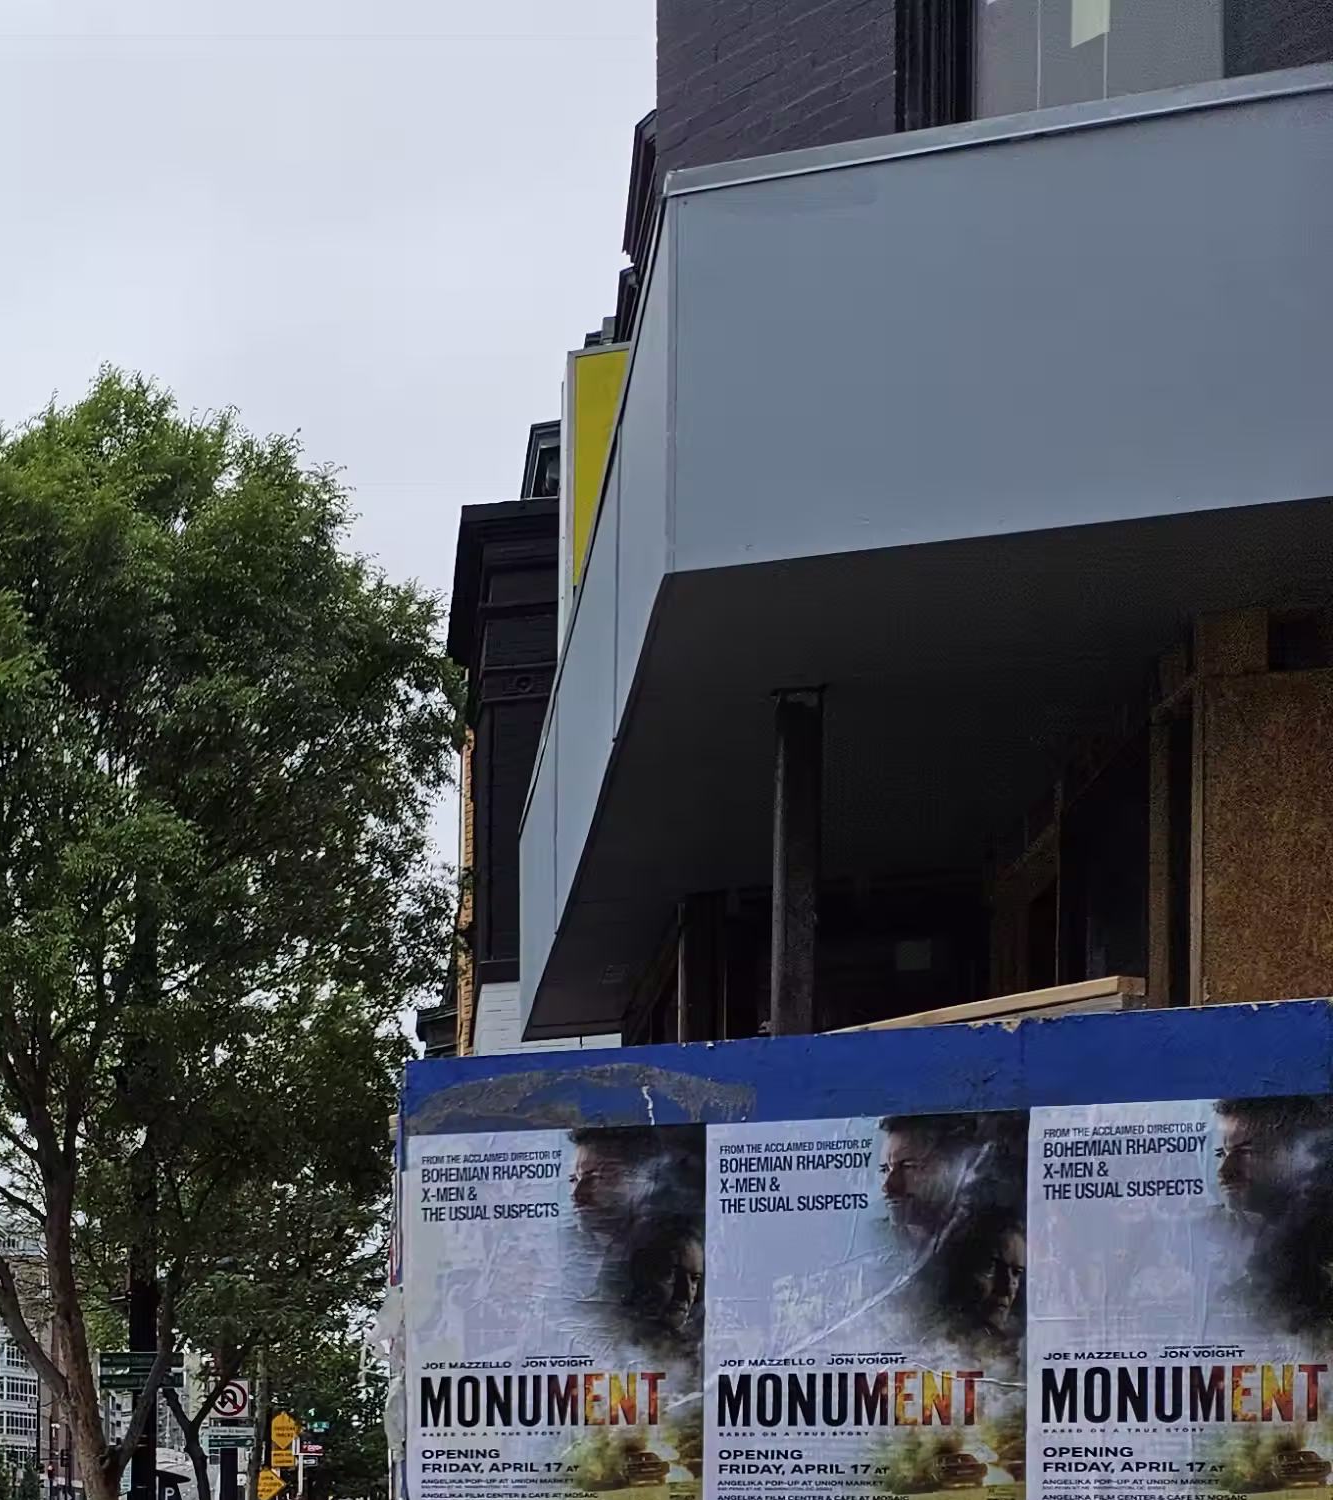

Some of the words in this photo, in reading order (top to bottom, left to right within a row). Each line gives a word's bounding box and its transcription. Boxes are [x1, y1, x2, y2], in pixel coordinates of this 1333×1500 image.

[1044, 1128, 1070, 1139] FROM
[1073, 1127, 1089, 1137] THE
[1092, 1125, 1144, 1136] ACCLAIMED
[1147, 1123, 1193, 1135] DIRECTOR
[1195, 1122, 1207, 1132] OF
[1044, 1140, 1122, 1158] BOHEMIAN
[1126, 1136, 1206, 1155] RHAPSODY
[720, 1156, 793, 1173] BOHEMIAN
[796, 1152, 872, 1170] RHAPSODY
[1043, 1162, 1093, 1179] X-MEN
[1097, 1161, 1109, 1177] &
[422, 1168, 489, 1183] BOHEMIAN
[493, 1163, 561, 1181] RHAPSODY
[720, 1178, 766, 1193] X-MEN
[769, 1176, 780, 1192] &
[1043, 1183, 1071, 1200] THE
[1075, 1182, 1123, 1199] USUAL
[1126, 1179, 1203, 1197] SUSPECTS
[421, 1187, 465, 1202] X-MEN
[468, 1186, 478, 1200] &
[422, 1207, 445, 1222] THE
[449, 1205, 490, 1221] USUAL
[494, 1202, 559, 1219] SUSPECTS
[720, 1198, 746, 1214] THE
[749, 1196, 794, 1213] USUAL
[797, 1193, 868, 1211] SUSPECTS
[719, 1359, 745, 1367] JOE
[748, 1358, 816, 1366] MAZZELLO
[826, 1357, 856, 1365] JON
[858, 1356, 908, 1365] VOIGHT
[1043, 1352, 1072, 1360] JOE
[1074, 1351, 1147, 1360] MAZZELLO
[1159, 1350, 1190, 1359] JON
[1192, 1350, 1245, 1359] VOIGHT
[422, 1361, 446, 1369] JOE
[449, 1361, 512, 1369] MAZZELLO
[522, 1360, 547, 1368] JON
[549, 1359, 595, 1368] VOIGHT
[421, 1372, 666, 1427] MONUMENT
[717, 1371, 983, 1427] MONUMENT
[1042, 1364, 1328, 1423] MONUMENT
[422, 1449, 500, 1459] OPENING
[718, 1450, 803, 1460] OPENING
[1043, 1446, 1133, 1458] OPENING
[422, 1463, 484, 1475] FRIDAY,
[489, 1463, 539, 1473] APRIL
[544, 1463, 562, 1473] 17
[566, 1465, 580, 1473] AT
[718, 1464, 786, 1476] FRIDAY,
[789, 1464, 846, 1475] APRIL
[850, 1465, 871, 1475] 17
[875, 1467, 890, 1475] AT
[1043, 1461, 1115, 1474] FRIDAY,
[1120, 1461, 1180, 1473] APRIL
[1186, 1462, 1205, 1473] 17
[1210, 1465, 1224, 1473] AT
